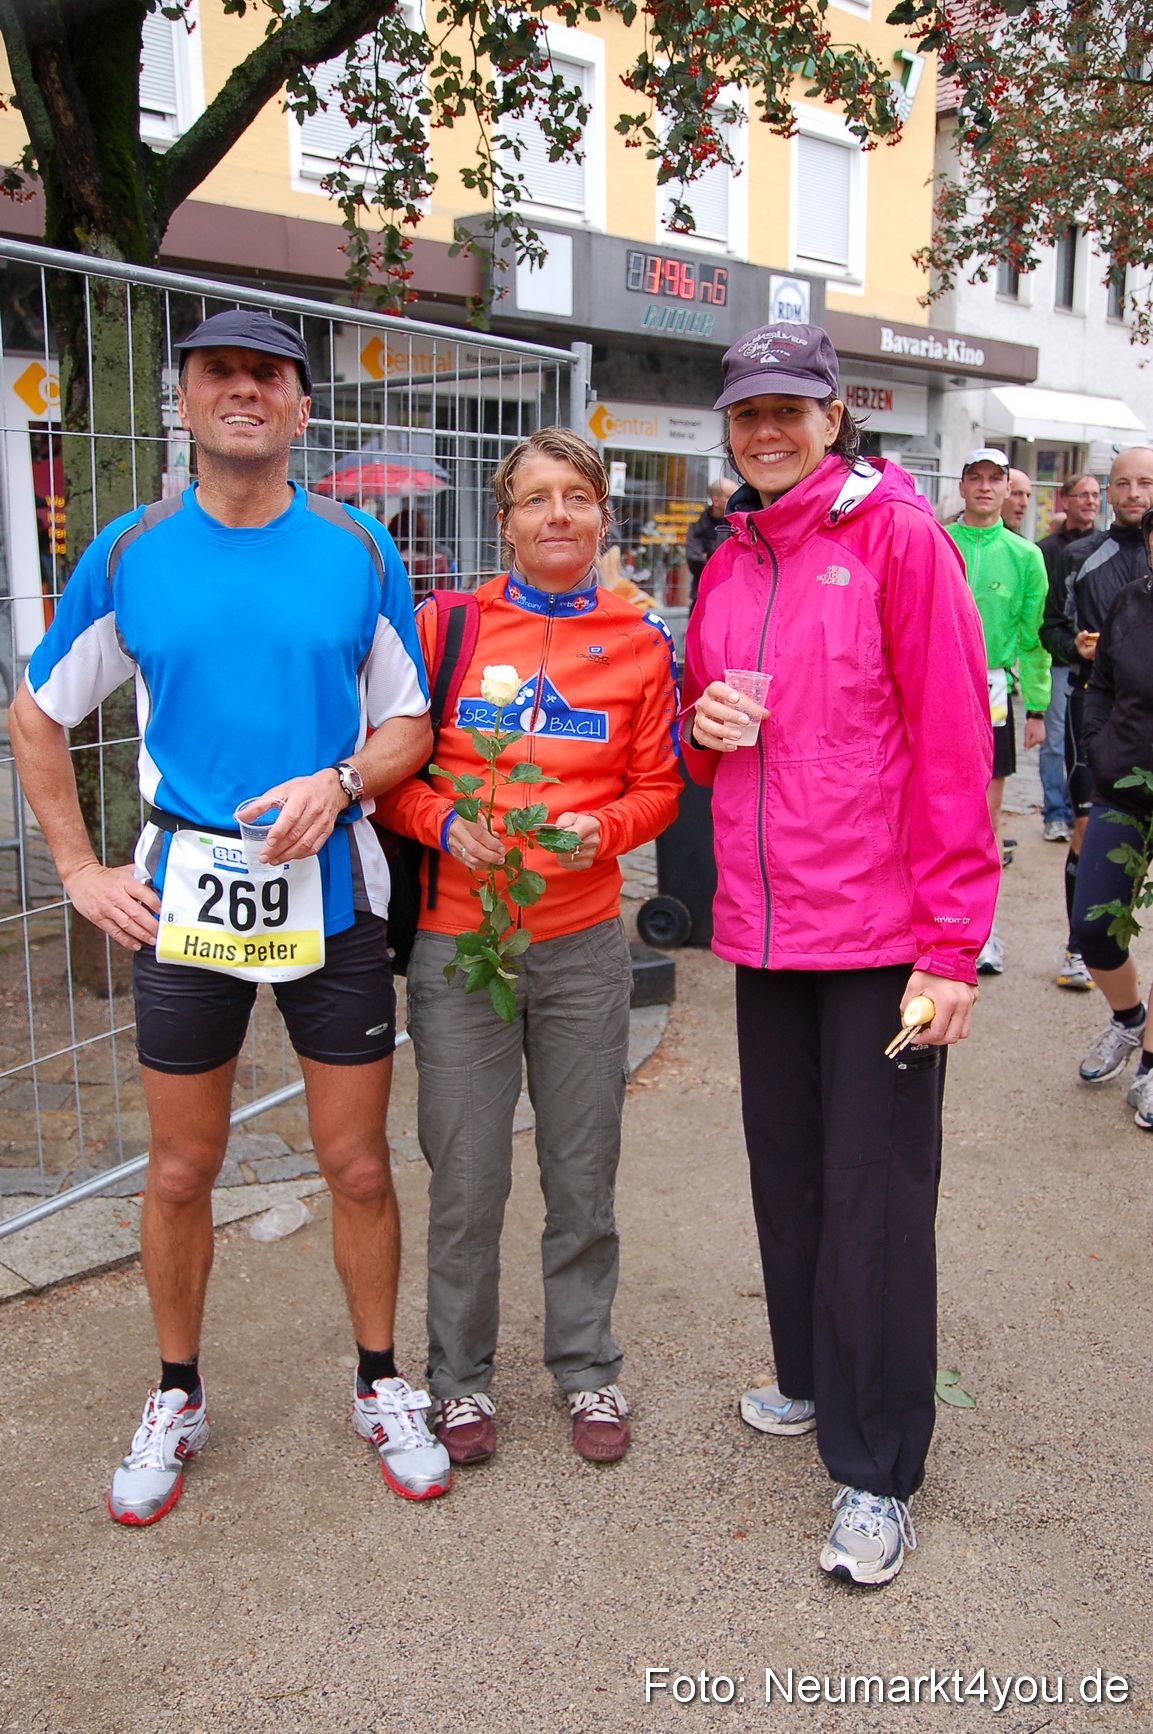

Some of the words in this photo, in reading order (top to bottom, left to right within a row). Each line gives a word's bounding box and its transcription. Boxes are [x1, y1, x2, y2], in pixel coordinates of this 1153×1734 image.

[777, 302, 802, 322] RDM
[846, 384, 893, 411] HERZEN
[462, 708, 518, 726] SRSC
[197, 873, 289, 931] 269
[167, 912, 174, 923] B
[183, 935, 237, 960] Hans
[244, 941, 298, 963] Peter
